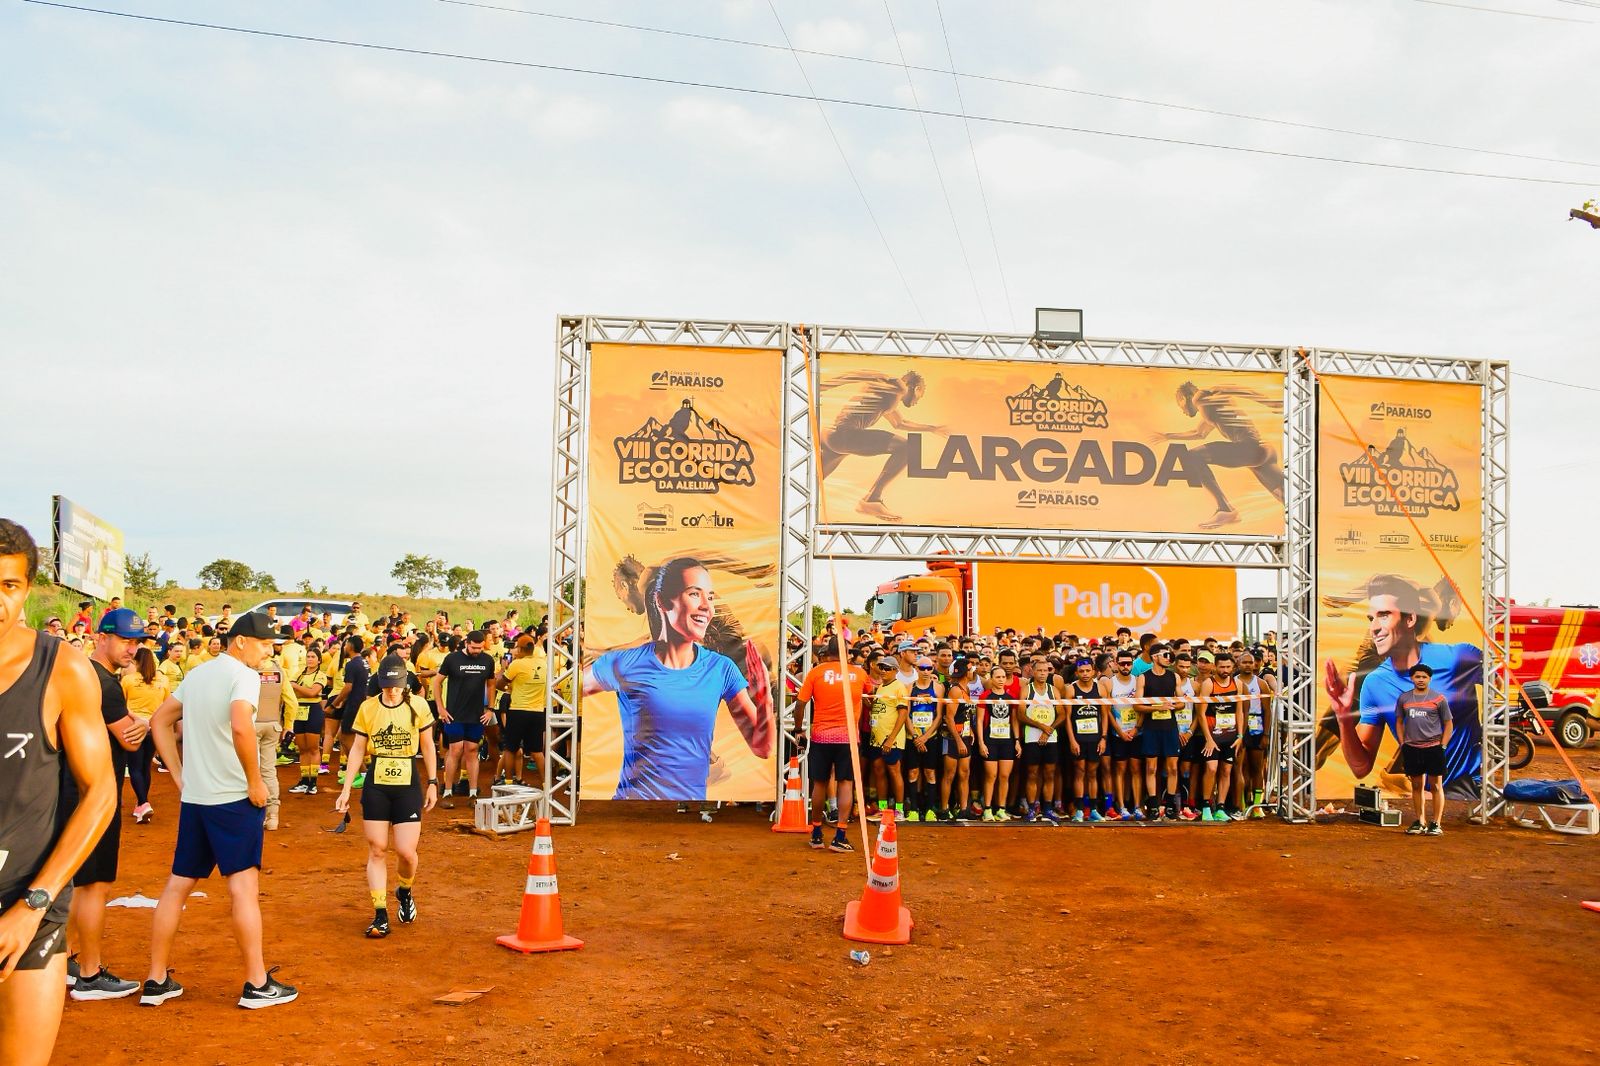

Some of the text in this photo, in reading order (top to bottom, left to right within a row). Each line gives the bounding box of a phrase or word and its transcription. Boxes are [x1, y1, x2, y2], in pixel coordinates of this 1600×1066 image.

[1008, 398, 1105, 413] VIII CORRIDA
[1012, 411, 1107, 427] ECOLÓGICA
[617, 440, 751, 462] VIII CORRIDA
[907, 432, 1203, 488] LARGADA
[622, 459, 752, 483] ECOLÓGICA
[1342, 466, 1456, 488] VIII CORRIDA
[659, 481, 716, 490] DA ALELUIA
[1377, 504, 1390, 512] DA
[1053, 583, 1154, 619] Palac
[385, 767, 402, 776] 562
